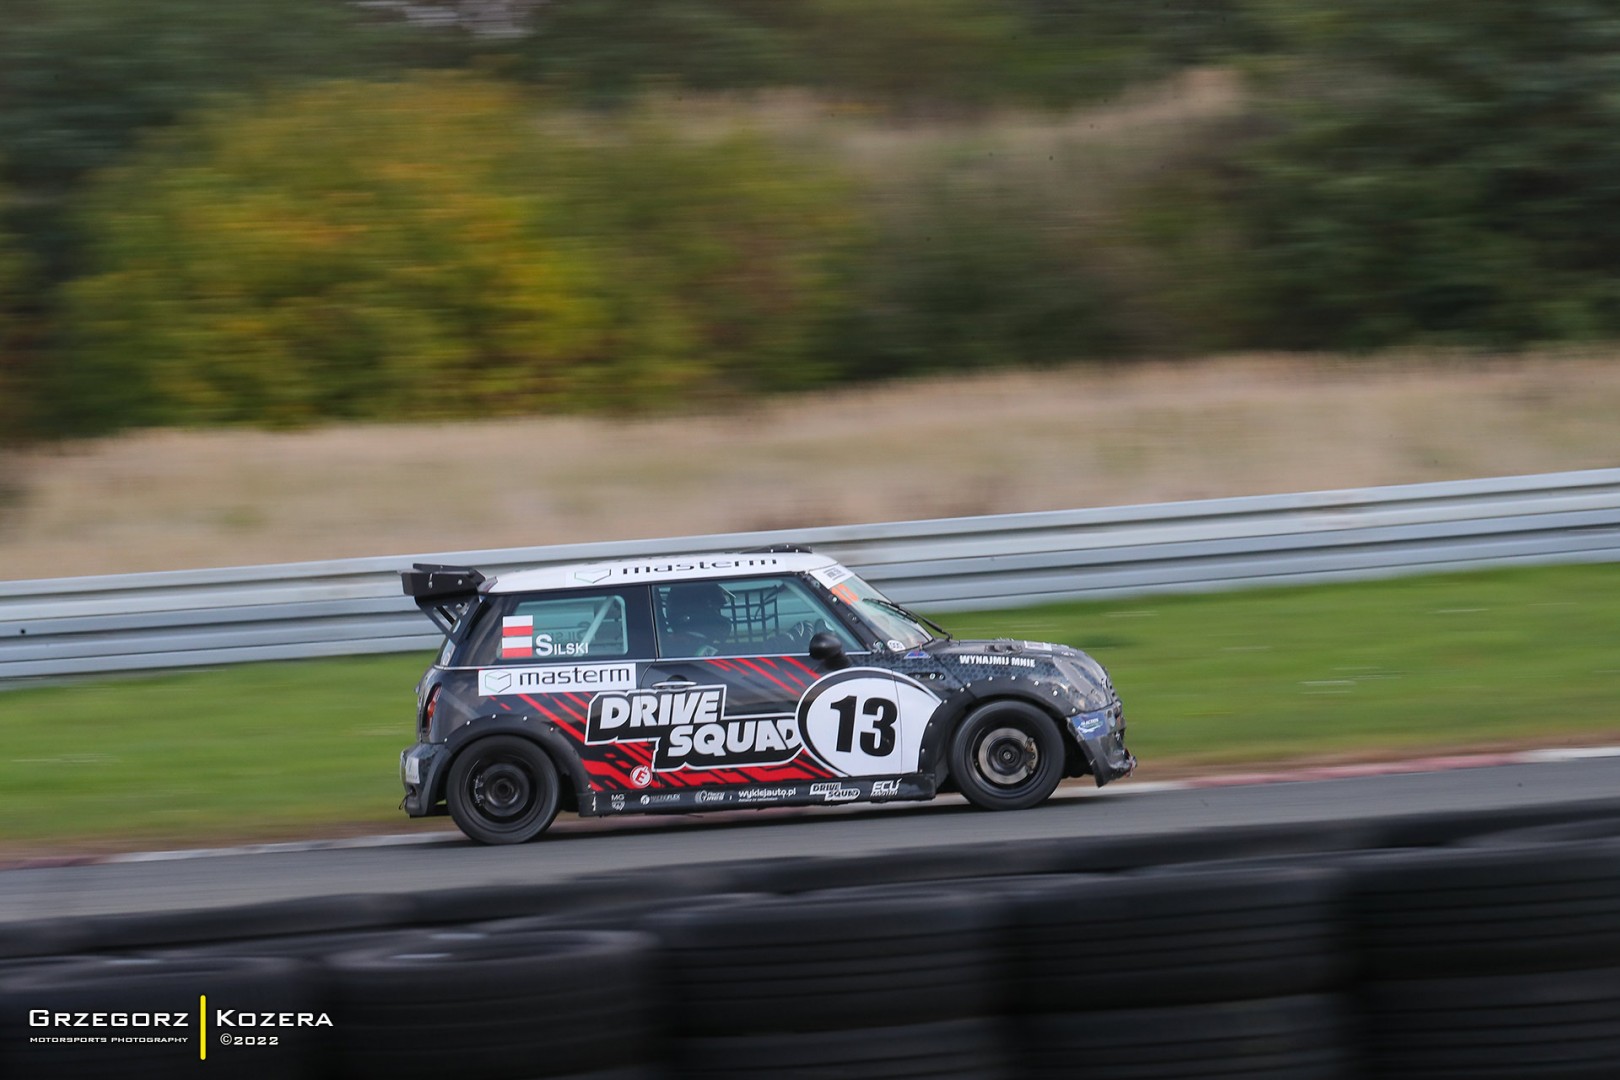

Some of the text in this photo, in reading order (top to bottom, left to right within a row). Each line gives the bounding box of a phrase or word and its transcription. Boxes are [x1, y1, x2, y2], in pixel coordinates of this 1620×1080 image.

[536, 634, 589, 656] SILSKI
[959, 655, 1036, 668] WYNAJMIJ MNIE
[519, 667, 630, 686] masterm
[600, 691, 721, 729] DRIVE
[830, 695, 898, 757] 13
[667, 718, 804, 757] SQUAD
[872, 778, 902, 791] ECU
